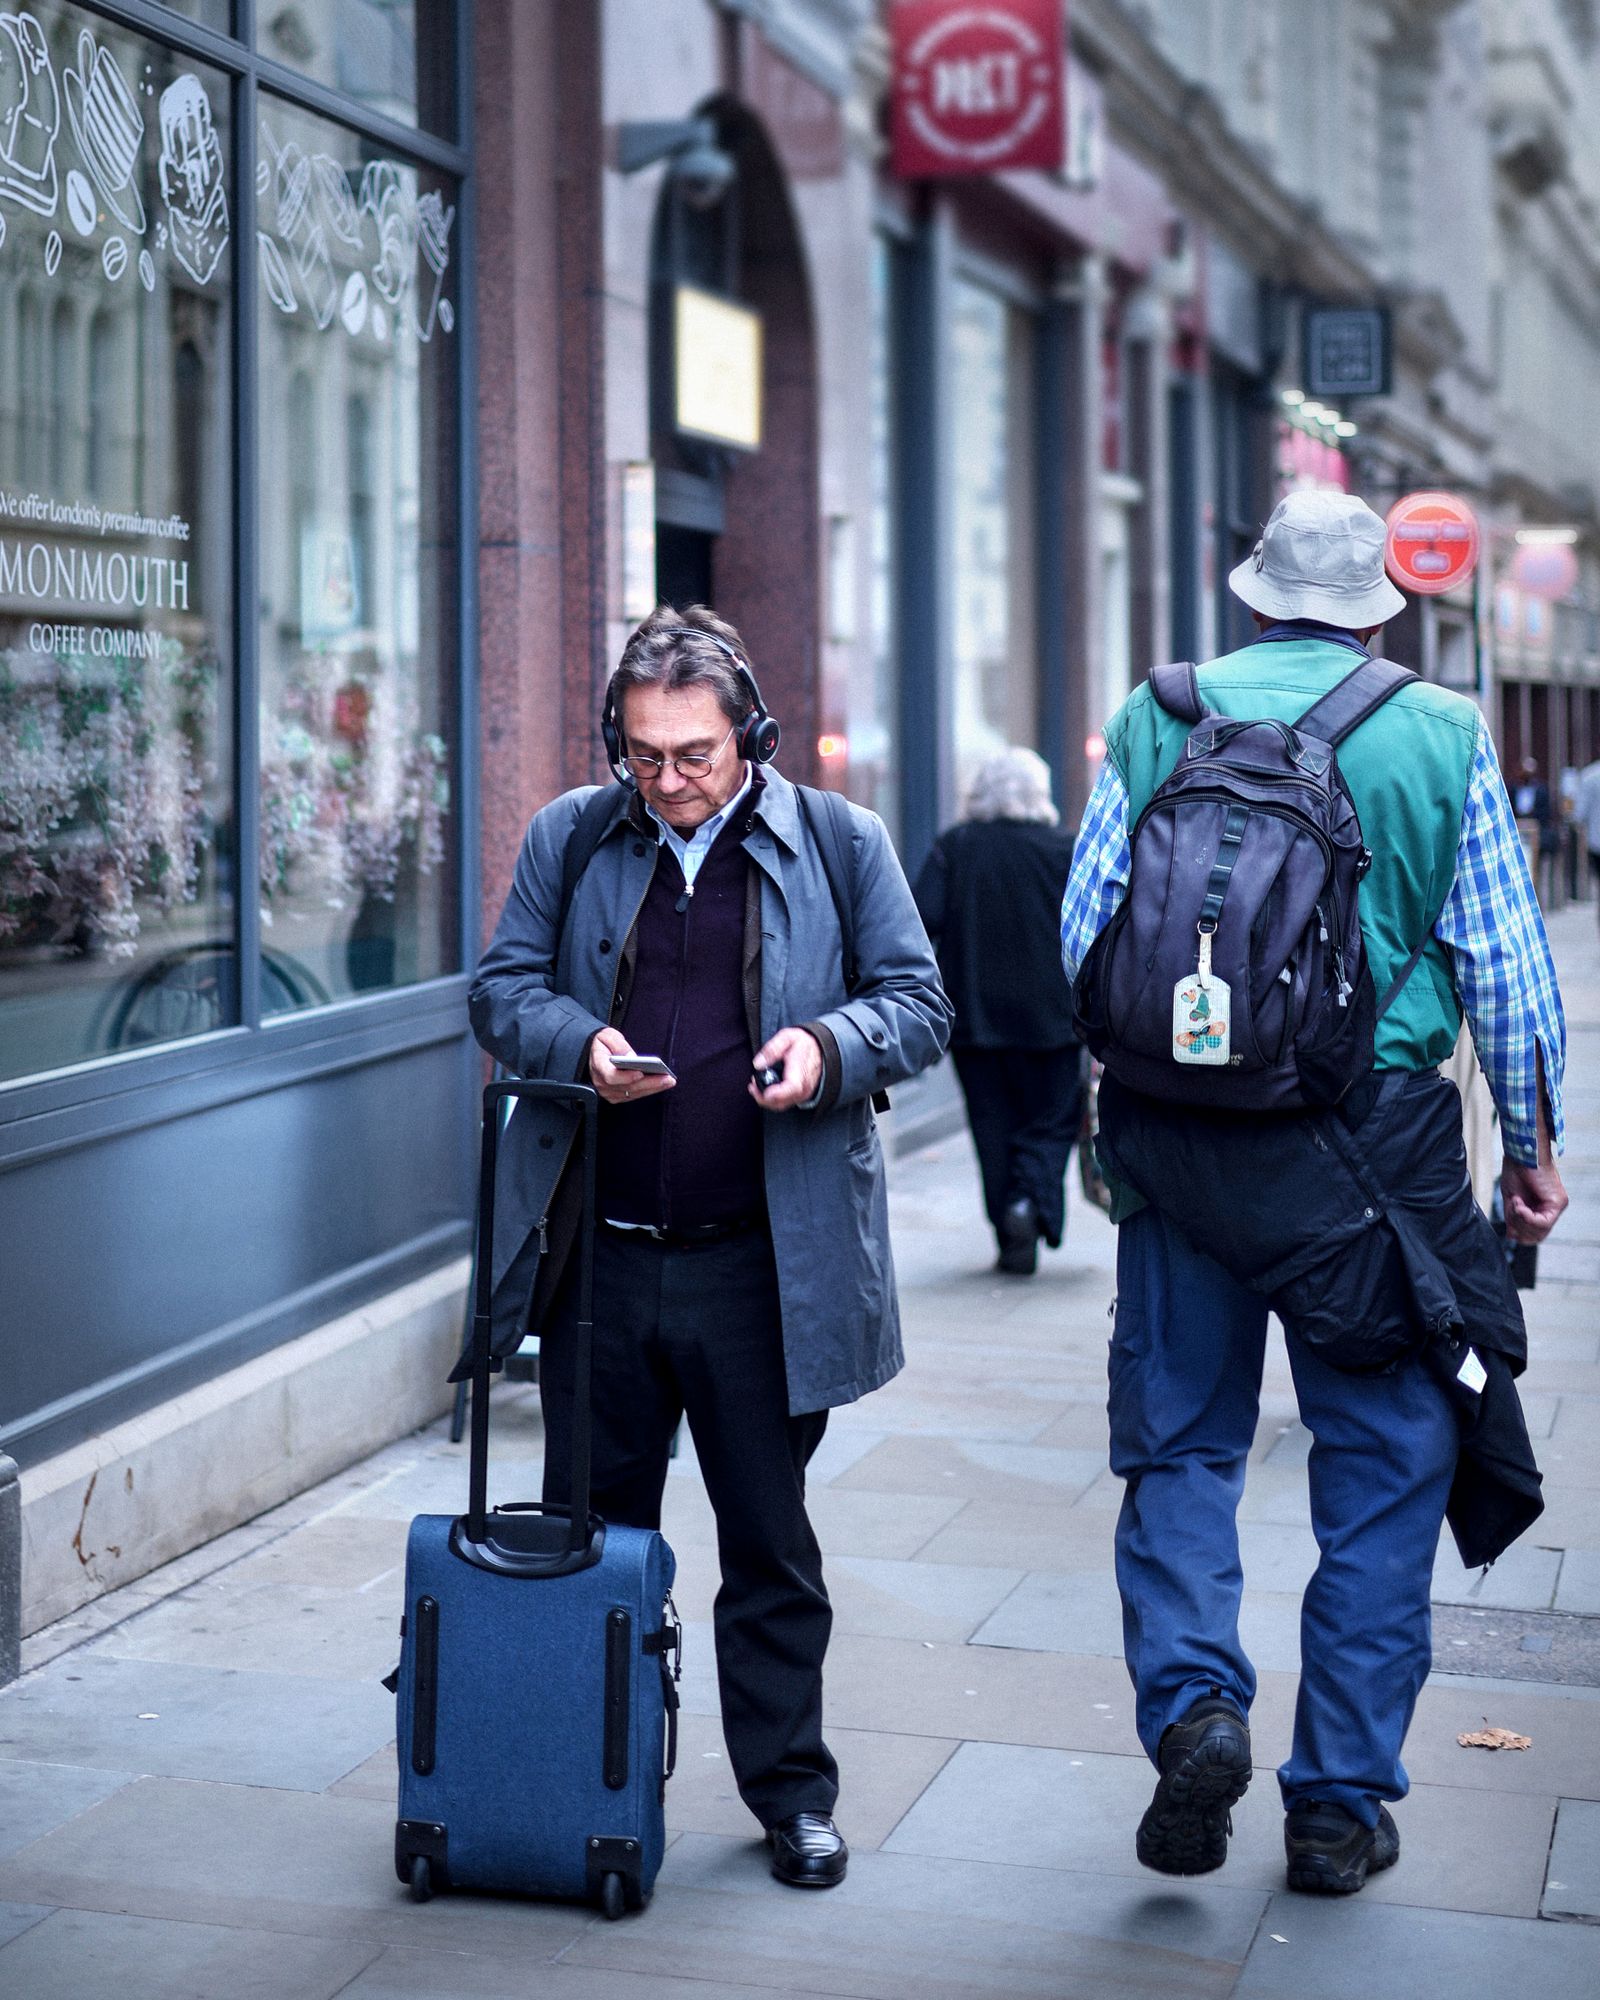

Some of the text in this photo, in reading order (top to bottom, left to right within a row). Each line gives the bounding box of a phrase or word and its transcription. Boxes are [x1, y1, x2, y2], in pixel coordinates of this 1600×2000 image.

[19, 493, 48, 520] offer
[50, 499, 101, 528] London's
[101, 511, 157, 536] premium
[158, 514, 190, 540] coffee
[0, 540, 189, 610] MONMOUTH
[30, 623, 162, 659] COFFEE COMPANY
